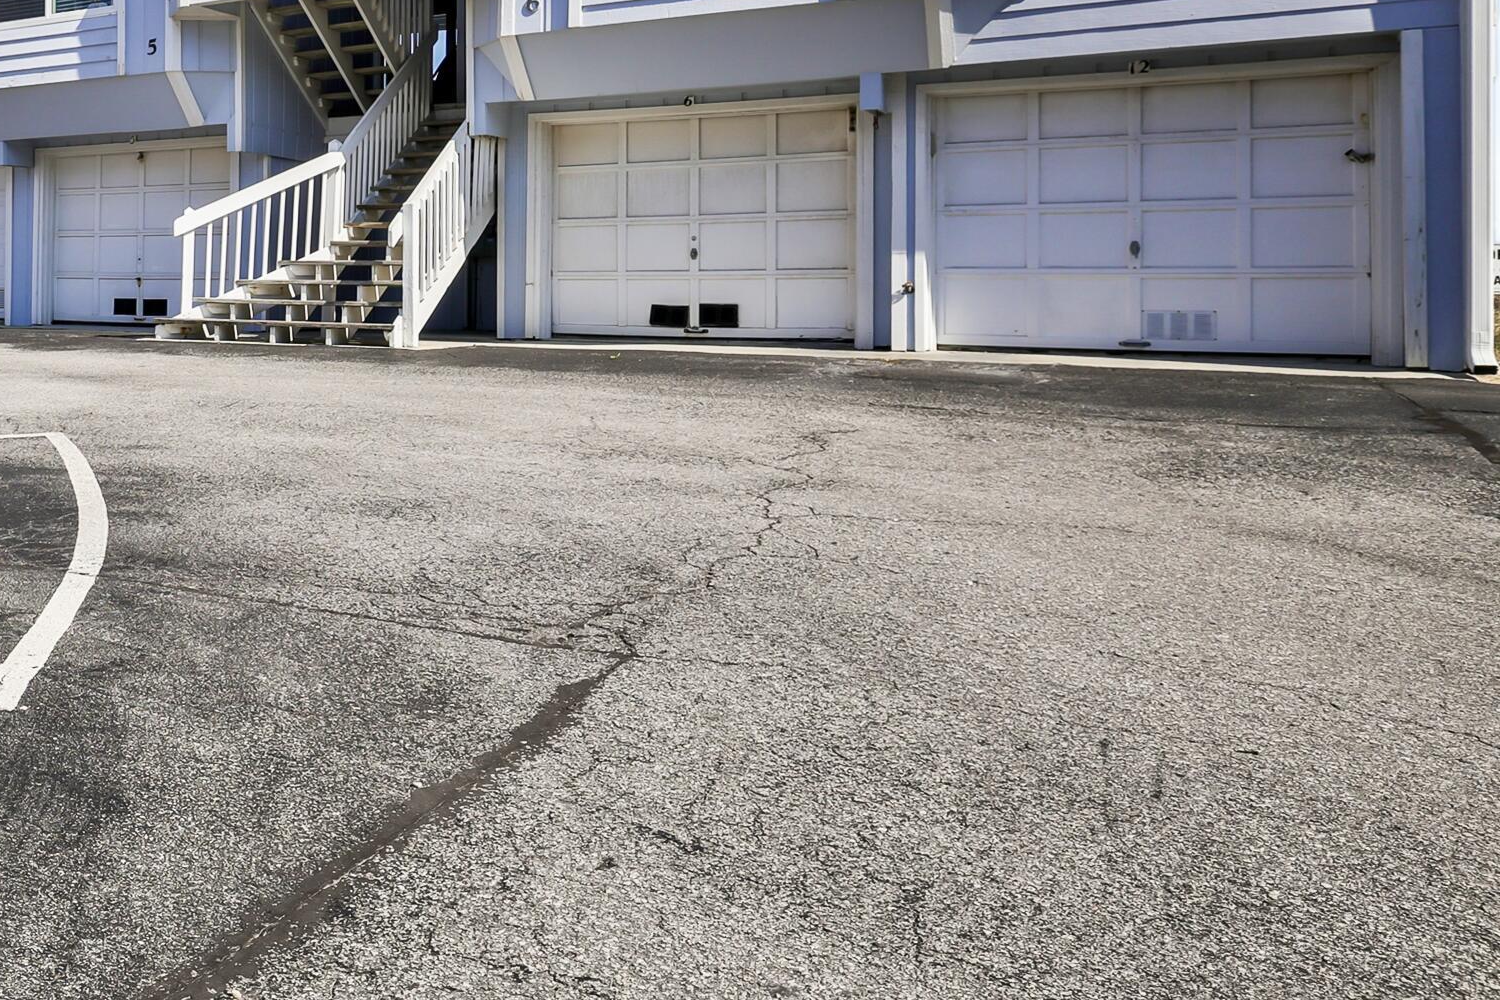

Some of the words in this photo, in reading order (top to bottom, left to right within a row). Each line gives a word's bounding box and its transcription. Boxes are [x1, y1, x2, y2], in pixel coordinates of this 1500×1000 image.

[146, 37, 157, 56] 5
[1130, 60, 1150, 75] 12
[683, 95, 693, 107] 6
